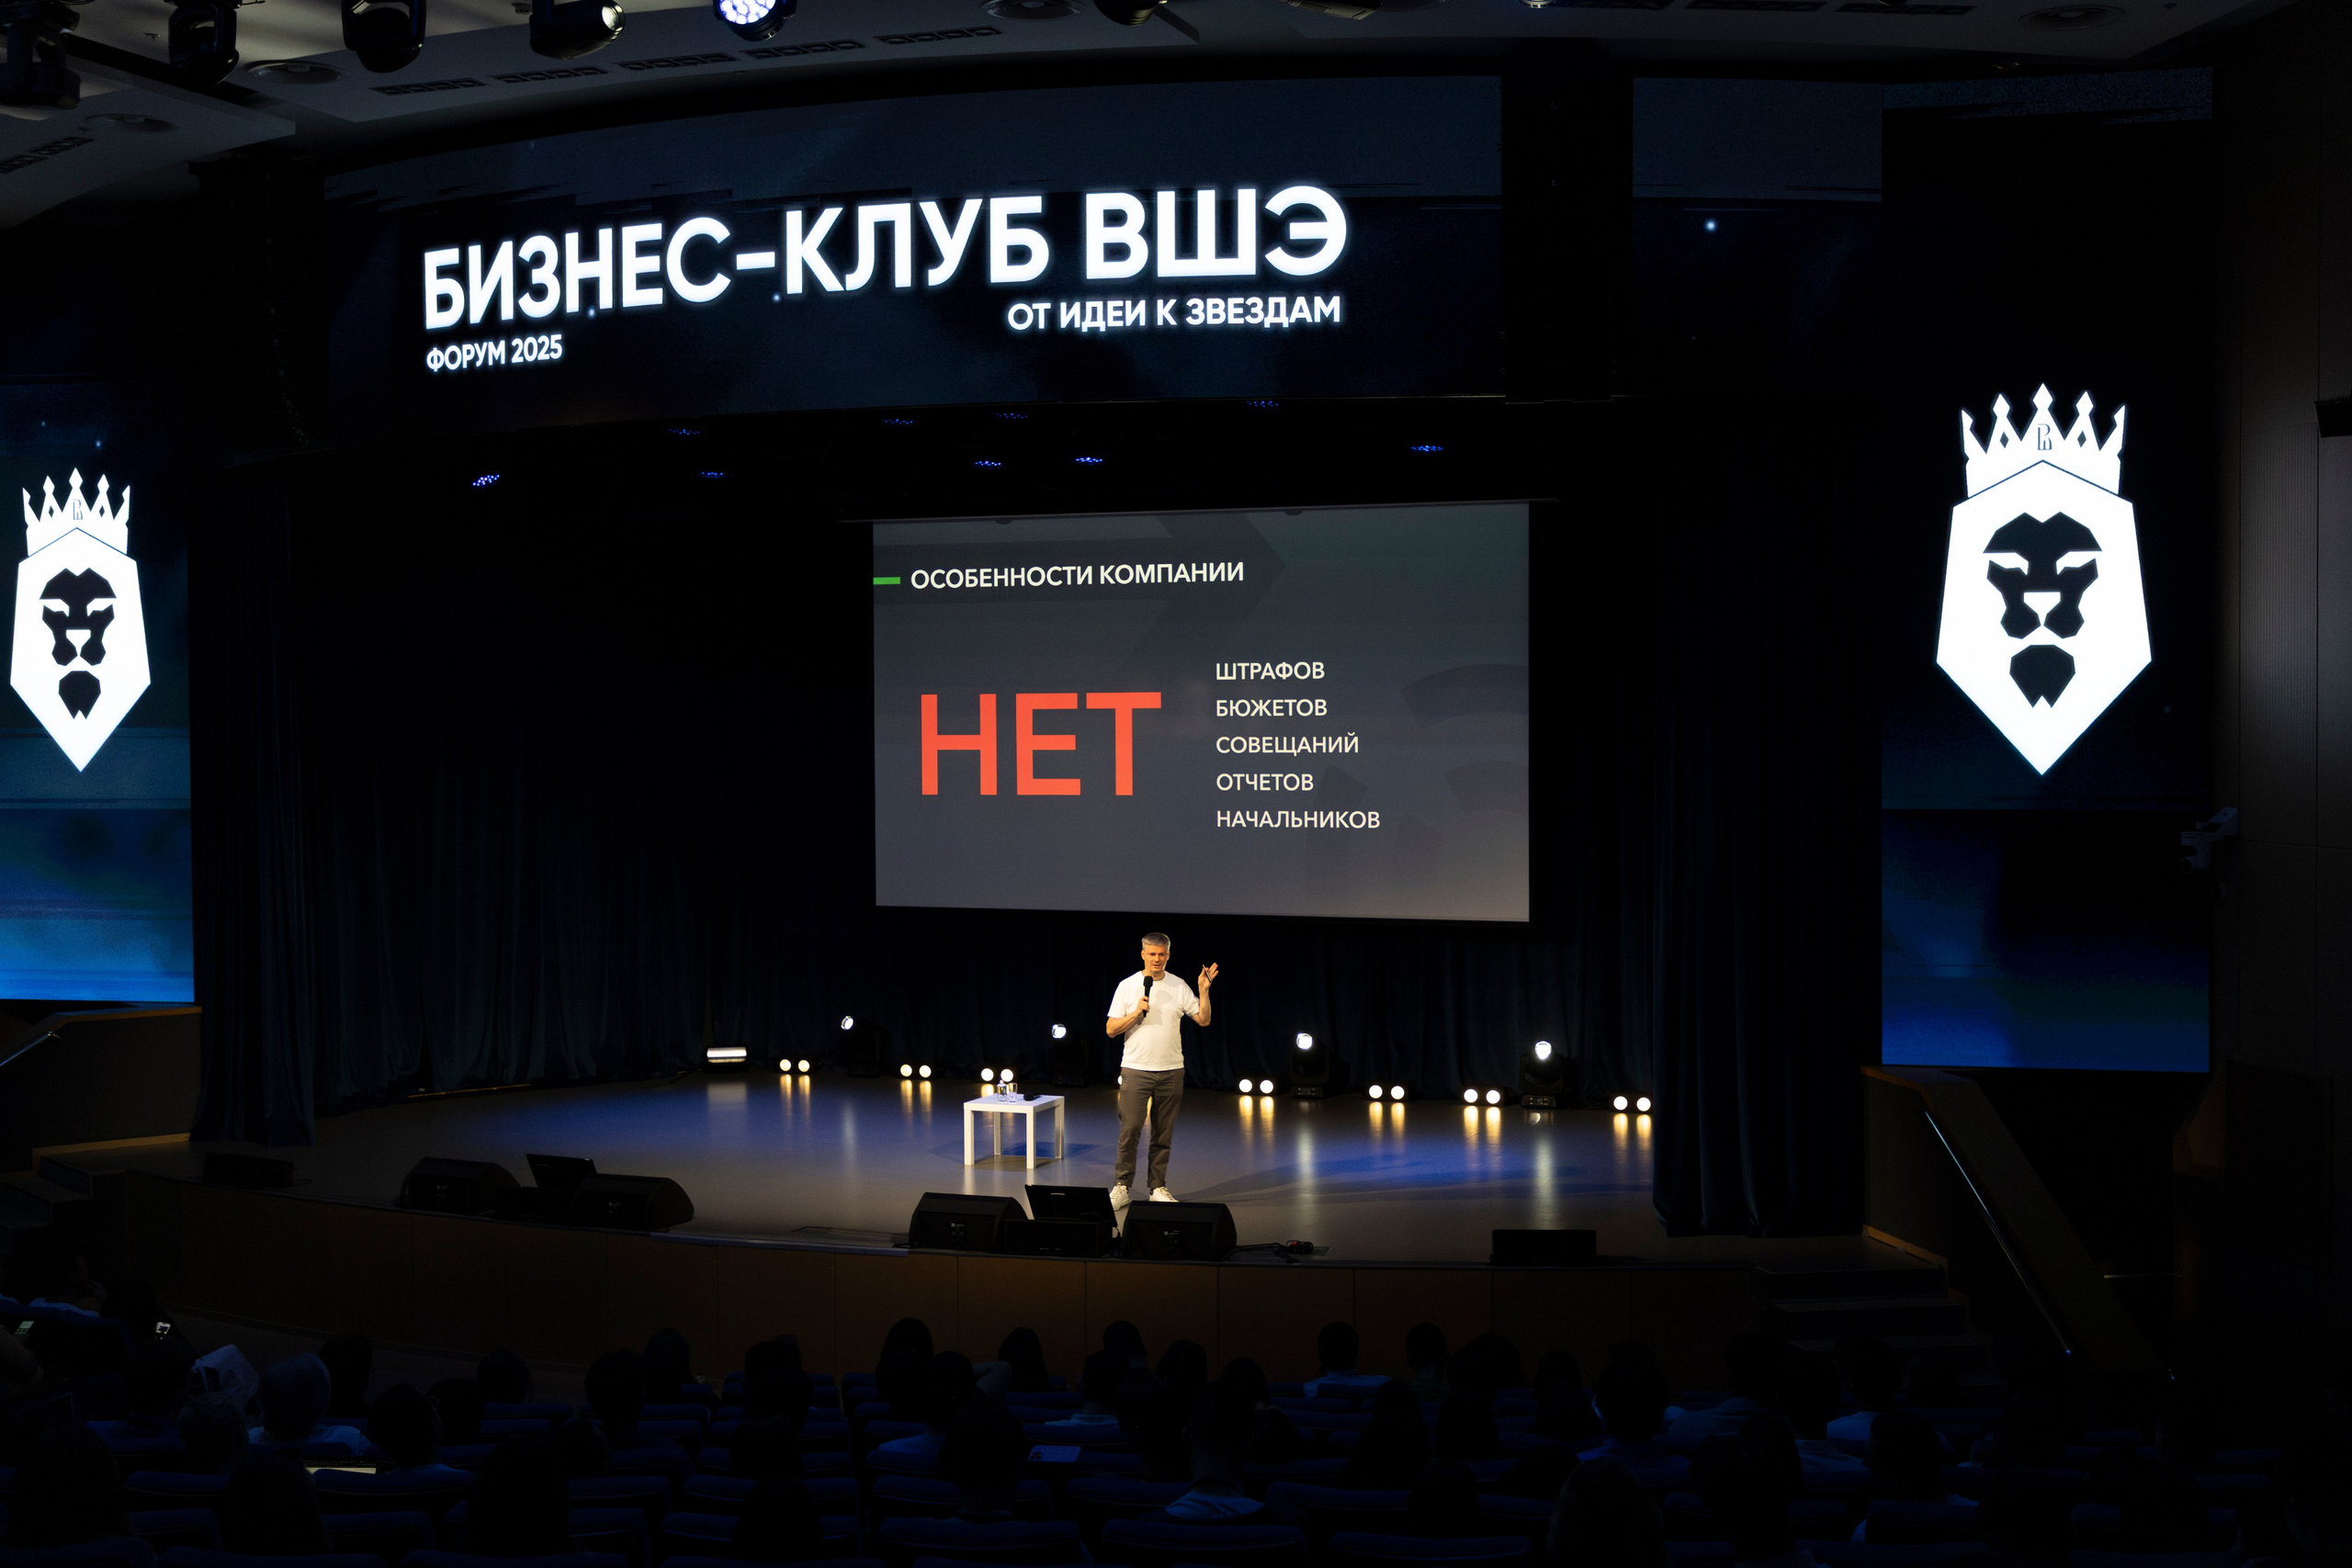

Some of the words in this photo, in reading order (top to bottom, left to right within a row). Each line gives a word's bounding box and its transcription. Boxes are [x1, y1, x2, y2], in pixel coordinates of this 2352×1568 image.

[424, 196, 1050, 330] БИЗНЕС-КЛУБ
[1086, 186, 1346, 279] ВШЭ
[1008, 302, 1051, 330] ОТ
[1060, 299, 1146, 332] ИДЕИ
[1157, 299, 1177, 325] К
[1186, 296, 1340, 328] ЗВЕЗДАМ
[426, 340, 505, 372] ФОРУМ
[512, 334, 562, 363] 2025
[911, 566, 1092, 589] ОСОБЕННОСТИ
[1101, 562, 1243, 584] КОМПАНИИ
[1216, 662, 1324, 680] ШТРАФОВ
[1217, 699, 1327, 716] БЮЖЕТОВ
[922, 693, 1161, 795] НЕТ
[1216, 732, 1358, 756] СОВЕЩАНИЙ
[1216, 773, 1313, 791] ОТЧЕТОВ
[1217, 811, 1380, 829] НАЧАЛЬНИКОВ
